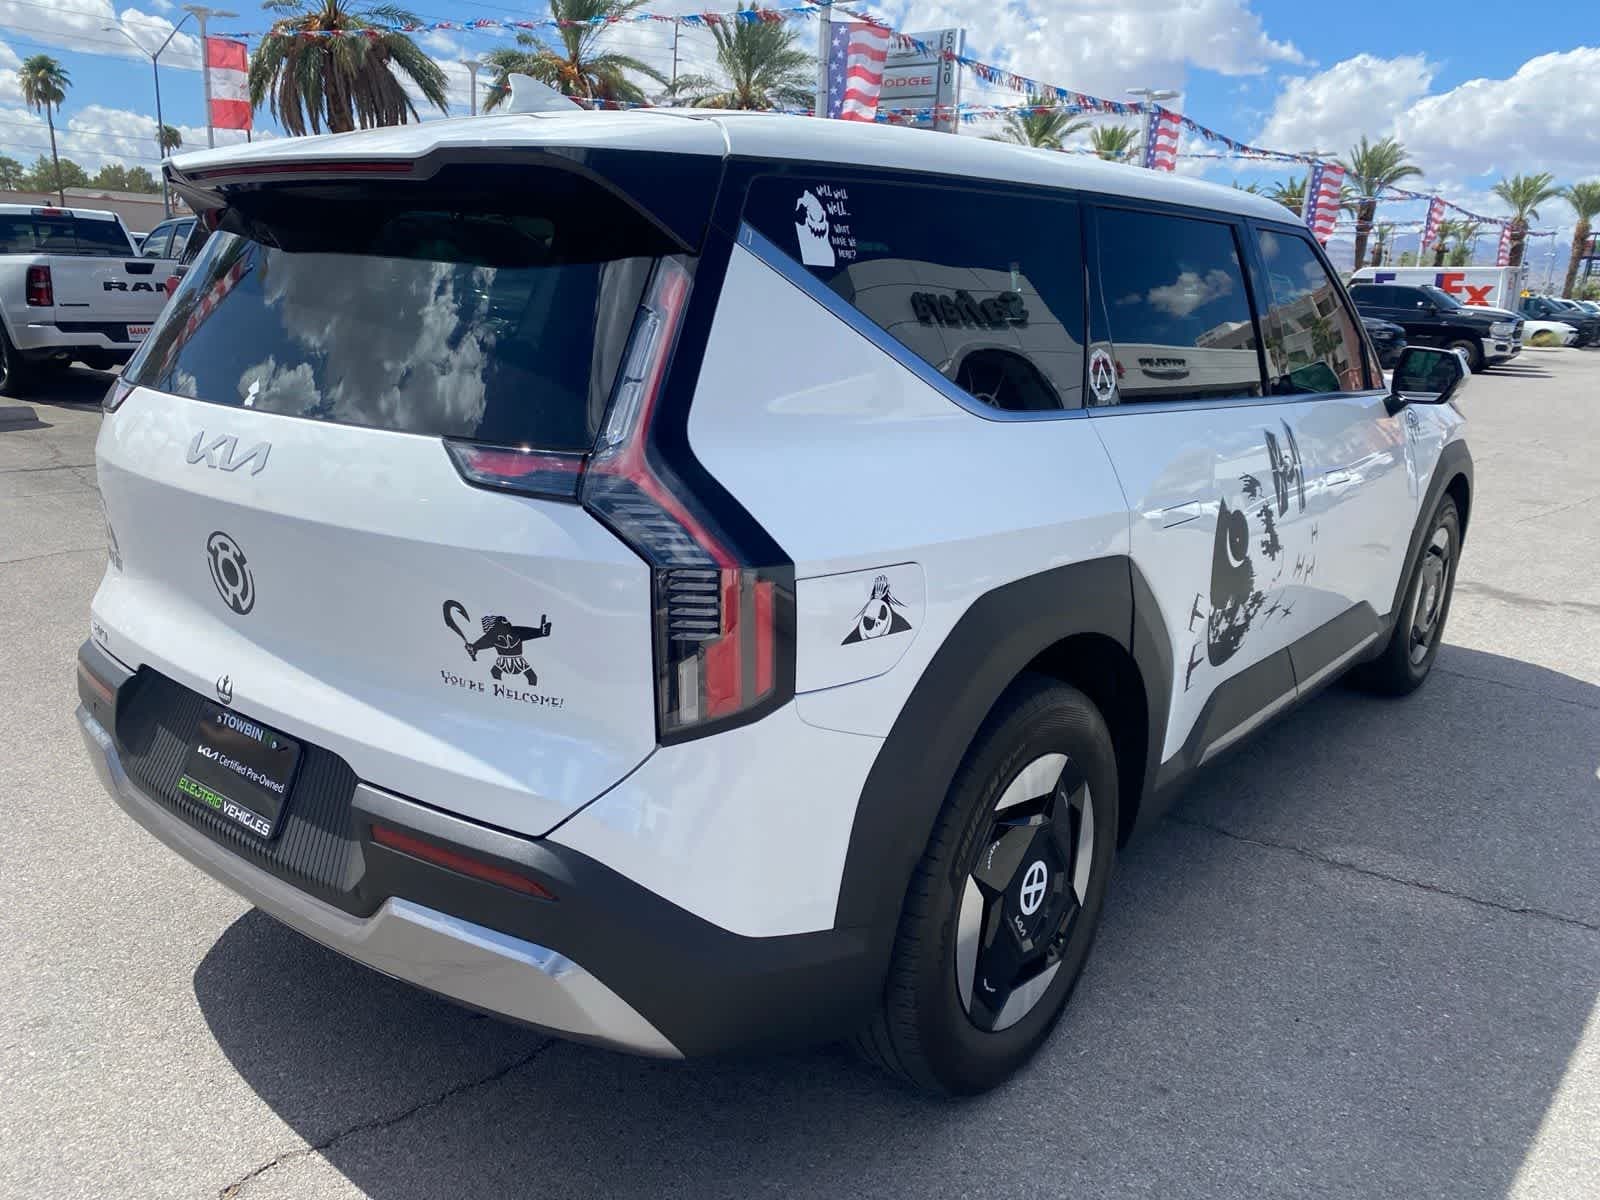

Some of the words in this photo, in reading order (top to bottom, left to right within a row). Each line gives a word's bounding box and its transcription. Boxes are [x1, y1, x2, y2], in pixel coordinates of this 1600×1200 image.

[882, 76, 931, 87] ODGE
[186, 431, 272, 476] KIA
[222, 712, 264, 743] TOWBIN
[219, 754, 247, 777] Certified
[246, 768, 284, 793] Pre-Owned
[177, 776, 222, 809] ELECTRIC
[223, 801, 271, 836] VEHICLES
